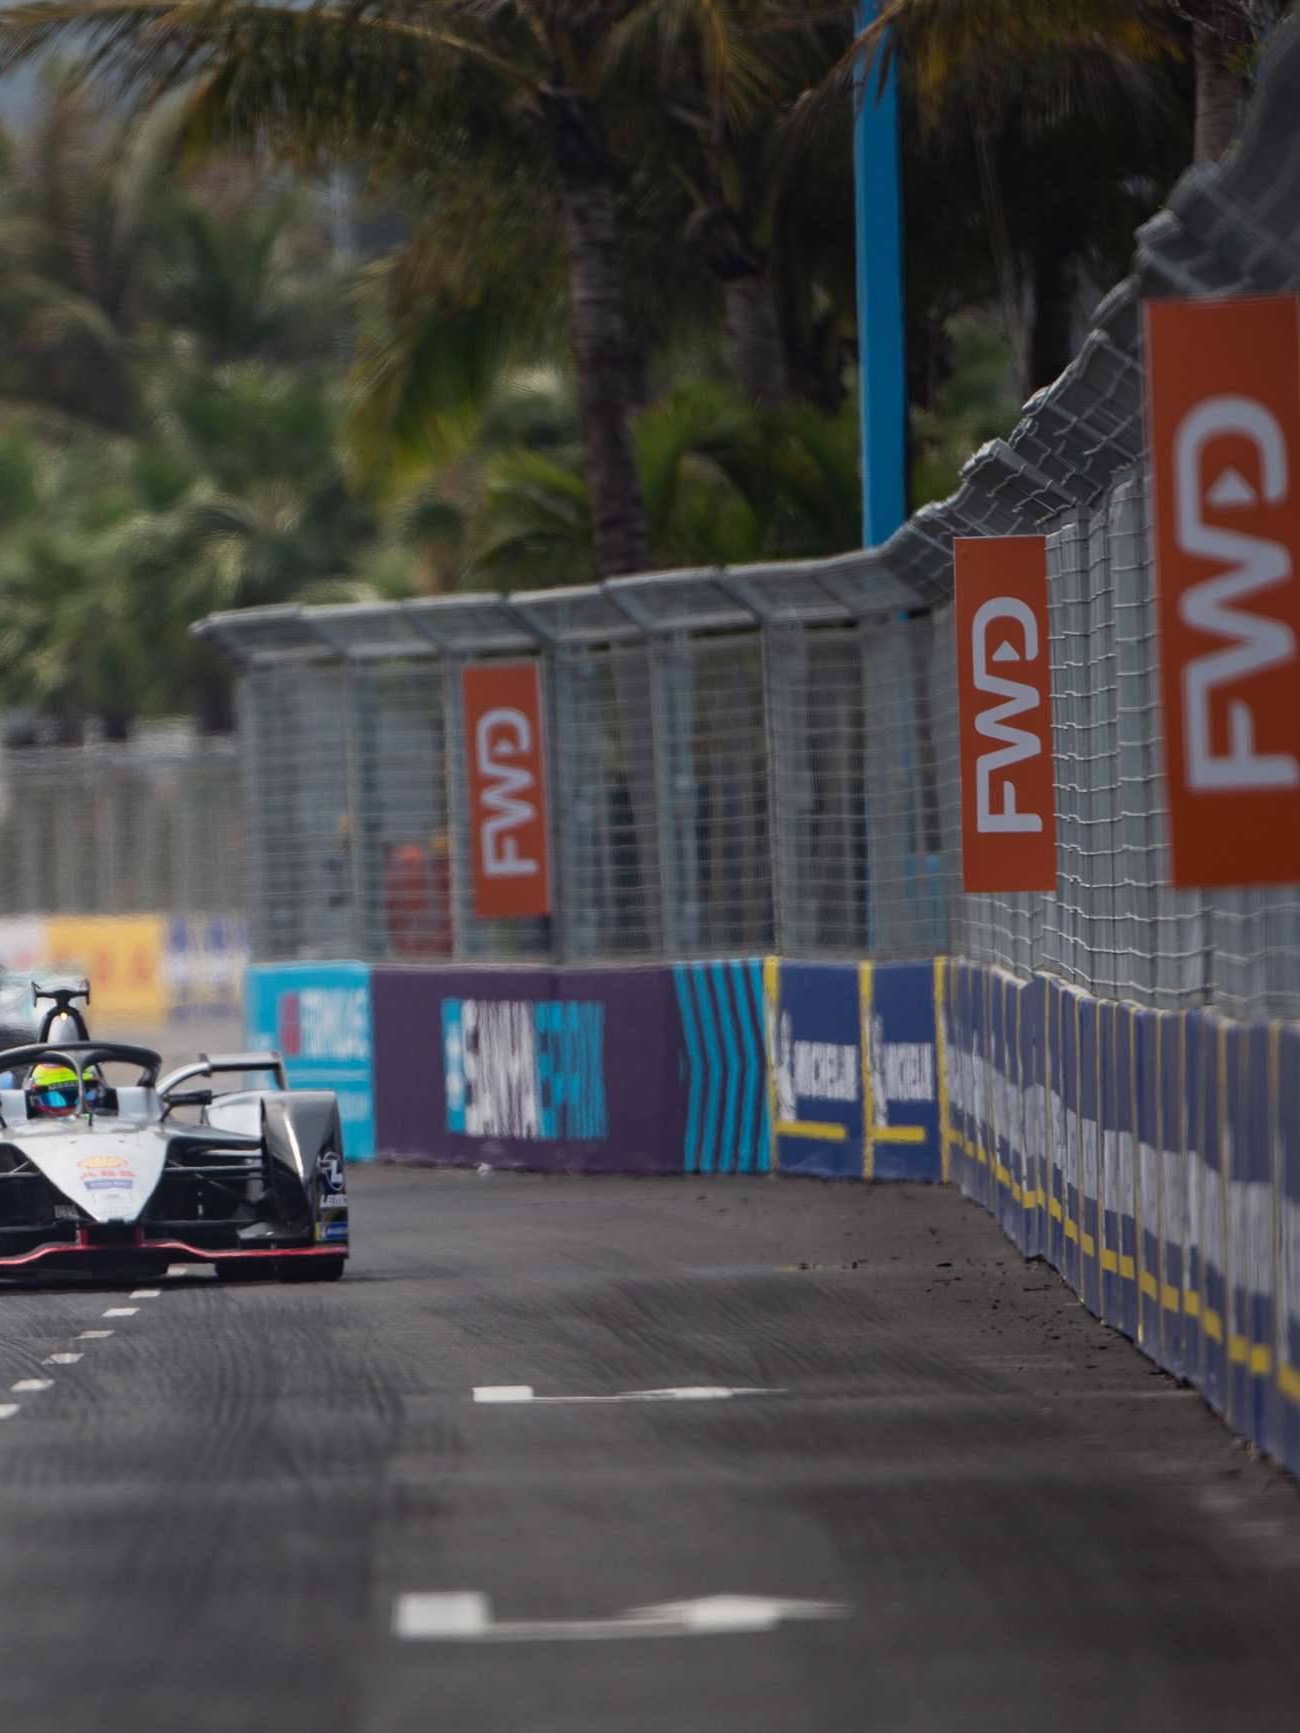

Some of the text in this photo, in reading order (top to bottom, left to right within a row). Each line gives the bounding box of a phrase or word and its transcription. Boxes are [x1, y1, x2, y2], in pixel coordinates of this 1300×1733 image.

[1175, 395, 1300, 790] FWD
[475, 707, 539, 878] FWD
[971, 596, 1043, 833] FWD
